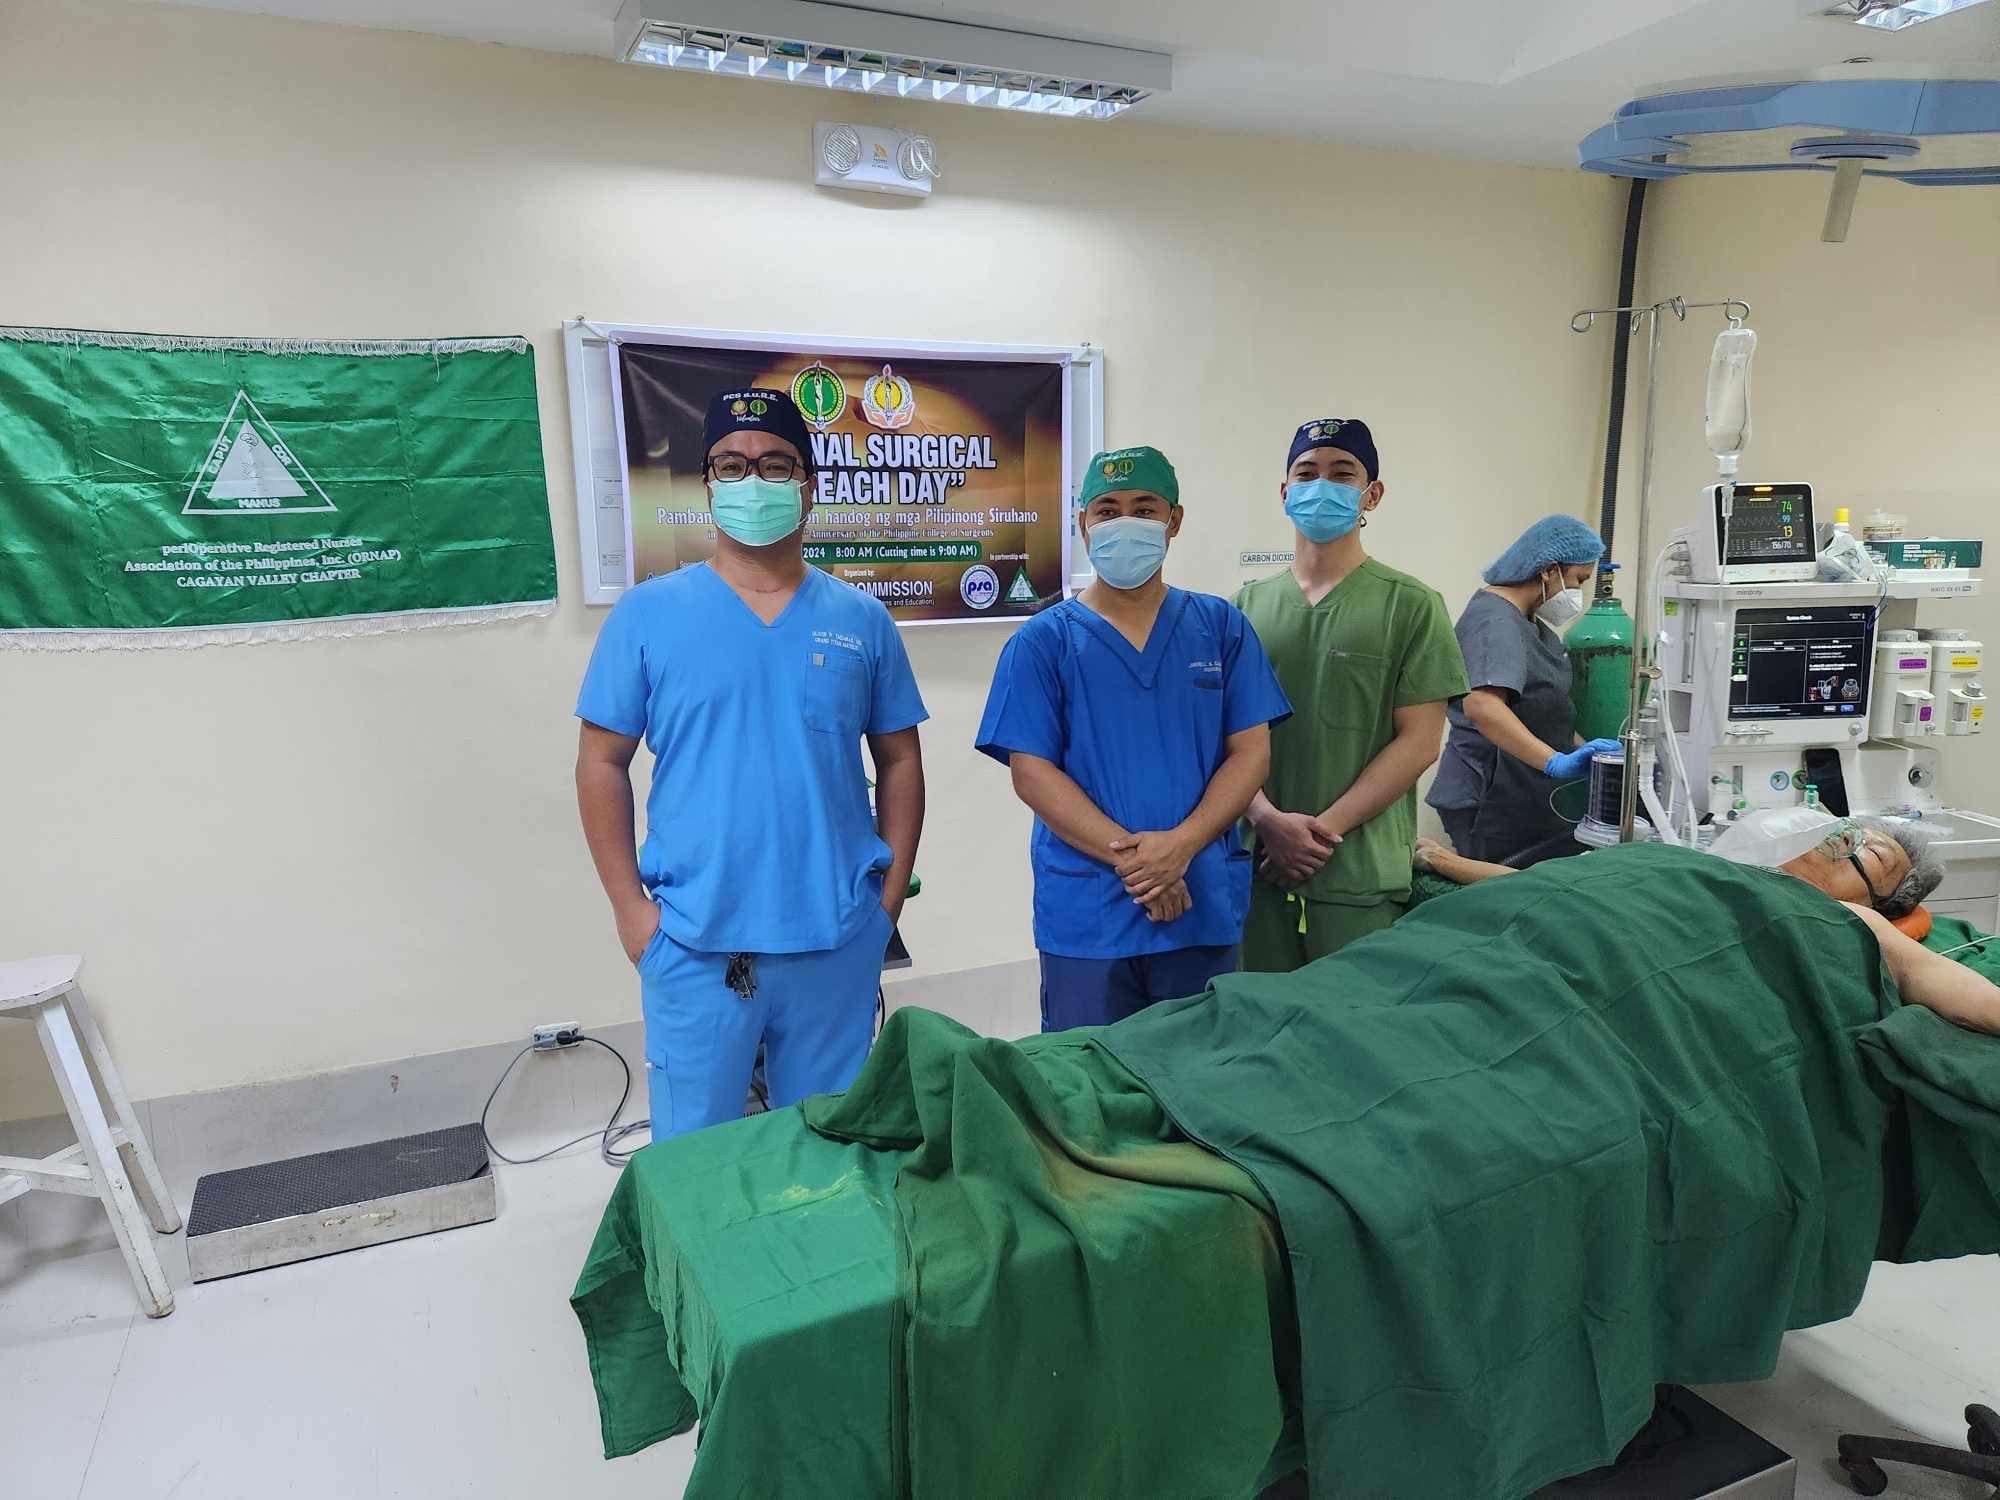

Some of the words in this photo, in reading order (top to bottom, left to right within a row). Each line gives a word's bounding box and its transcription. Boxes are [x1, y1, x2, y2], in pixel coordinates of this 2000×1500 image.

[207, 435, 233, 474] CAPUT
[271, 443, 293, 466] COR
[809, 432, 861, 467] NAL
[866, 433, 997, 468] SURGICAL
[813, 470, 892, 504] EACH
[239, 498, 281, 509] MANUS
[1780, 501, 1793, 513] 74
[656, 506, 713, 525] Pamban
[825, 508, 871, 526] handog
[876, 512, 891, 526] ng
[895, 511, 920, 526] mga
[925, 508, 984, 526] Pilipinong
[988, 507, 1038, 524] Siruhano
[1782, 514, 1791, 523] 99
[810, 529, 857, 540] Anniversary
[869, 528, 881, 538] the
[883, 528, 920, 540] Philippine
[959, 528, 995, 538] Surgeons
[1783, 525, 1793, 538] 13
[254, 540, 320, 555] Registered
[321, 537, 364, 549] Nurses
[803, 546, 826, 559] 2024
[835, 546, 856, 558] 8:00
[857, 546, 873, 558] AM
[875, 545, 909, 559] (Cutting
[910, 545, 928, 557] time
[929, 545, 936, 557] is
[938, 545, 957, 557] 9:00
[959, 545, 979, 558] AM)
[124, 560, 203, 572] Association
[204, 559, 220, 571] of
[220, 559, 244, 571] the
[245, 557, 320, 570] Philippines,
[321, 555, 346, 565] Inc.
[347, 549, 402, 565] (ORNAP)
[1242, 554, 1271, 563] CARBON
[1272, 553, 1295, 562] DIOXID
[176, 576, 246, 588] CAGAYAN
[246, 573, 299, 586] VALLEY
[300, 568, 362, 583] CHAPTER
